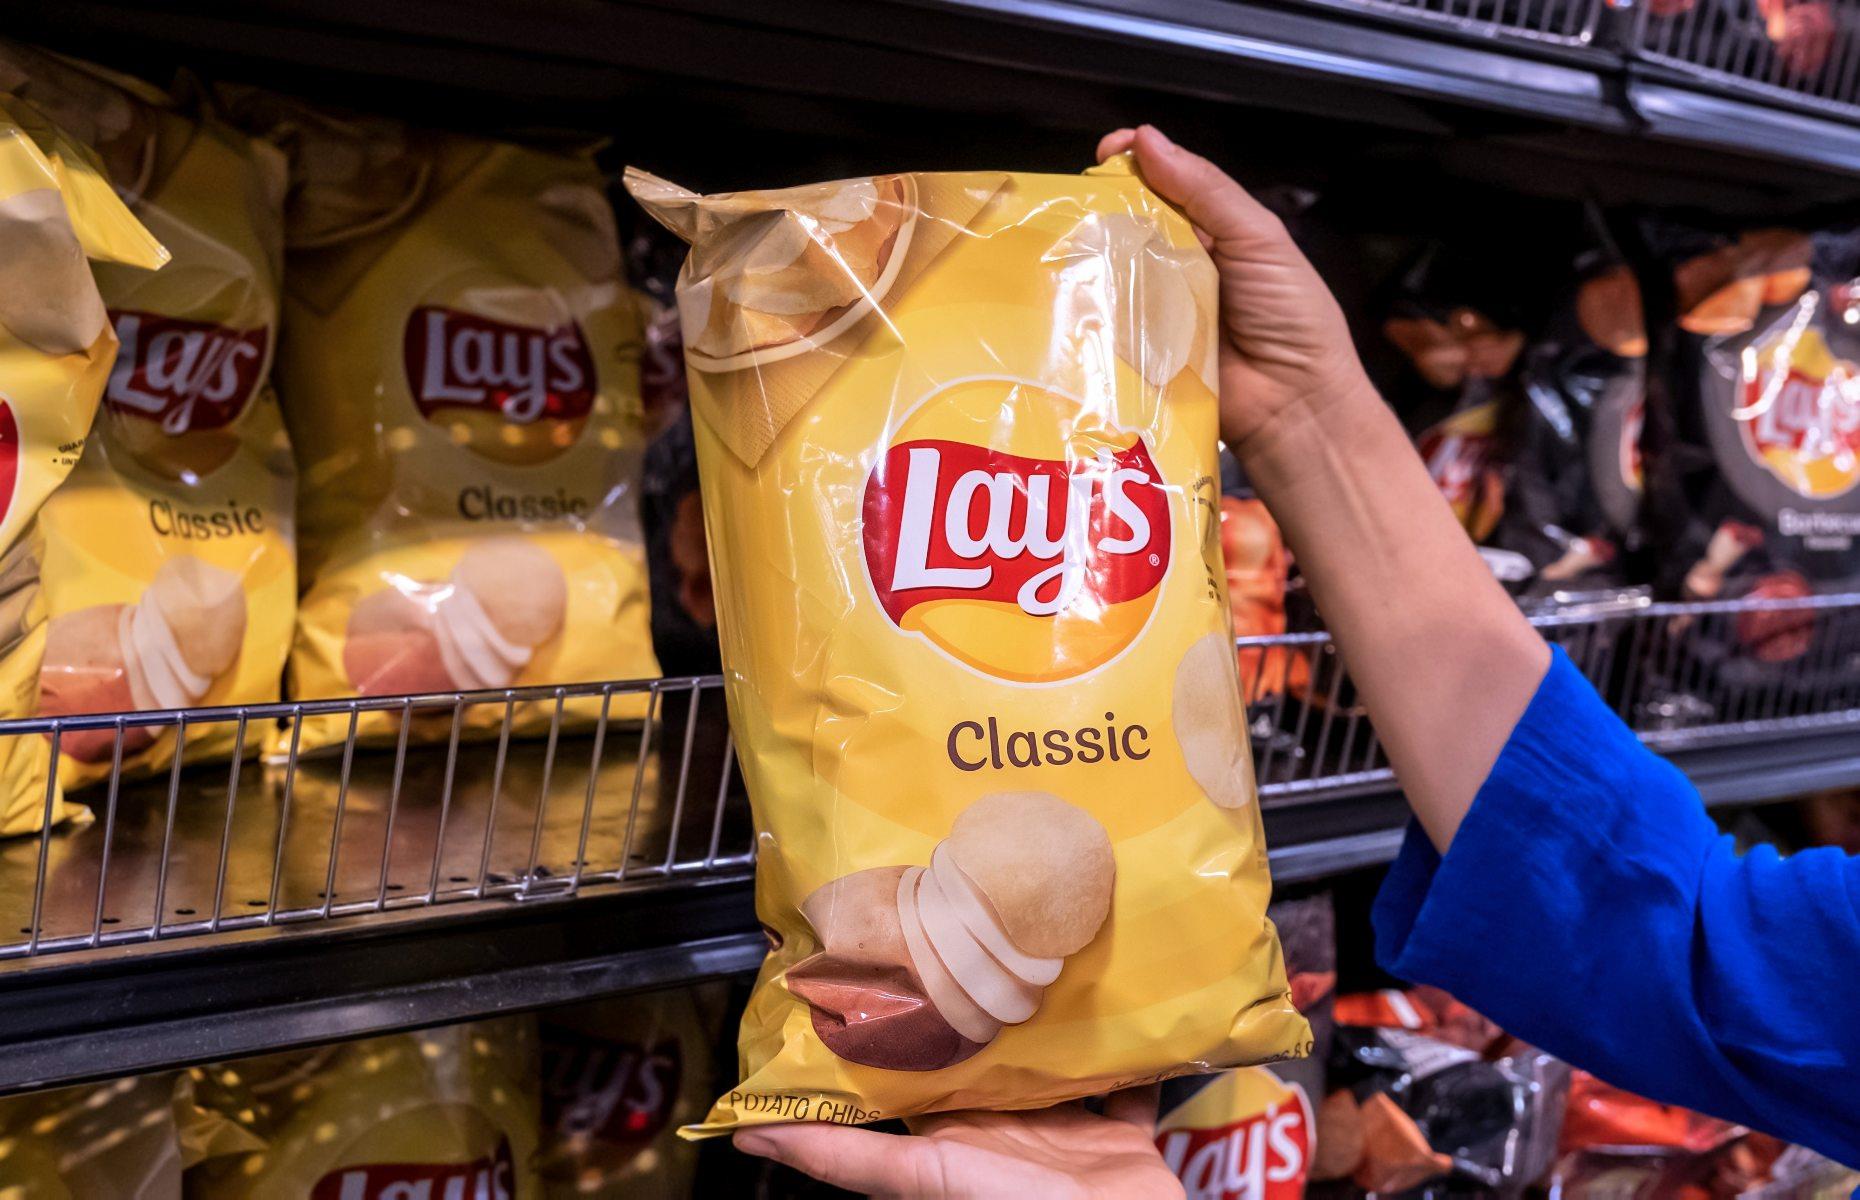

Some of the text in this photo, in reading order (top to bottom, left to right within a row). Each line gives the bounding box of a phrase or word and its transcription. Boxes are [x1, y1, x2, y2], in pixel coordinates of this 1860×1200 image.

[150, 498, 266, 540] Classic
[458, 485, 590, 521] Classic
[890, 446, 1151, 616] Lay's
[946, 711, 1151, 772] Classic
[729, 1091, 881, 1125] POTATO CHIPS
